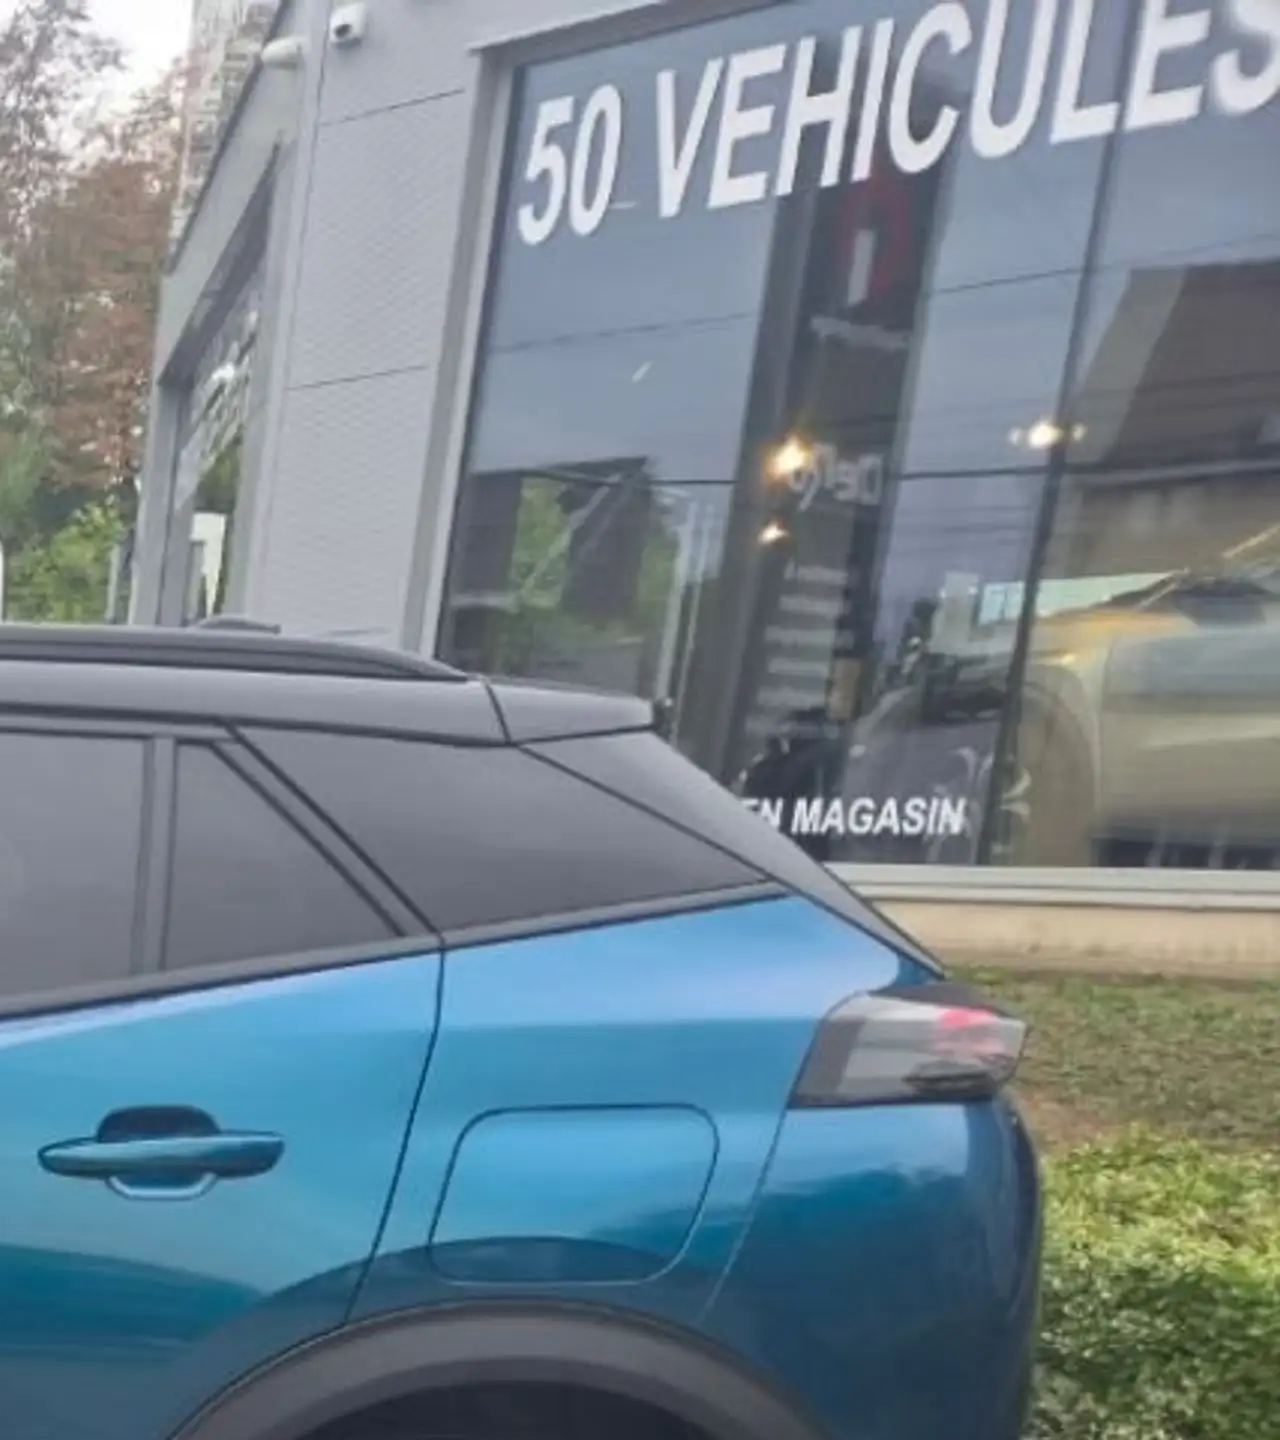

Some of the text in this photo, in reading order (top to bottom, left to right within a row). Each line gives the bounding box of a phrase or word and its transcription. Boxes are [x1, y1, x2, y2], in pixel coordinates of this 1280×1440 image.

[518, 0, 1280, 246] 50 VEHICULES
[791, 796, 967, 834] MAGASIN
